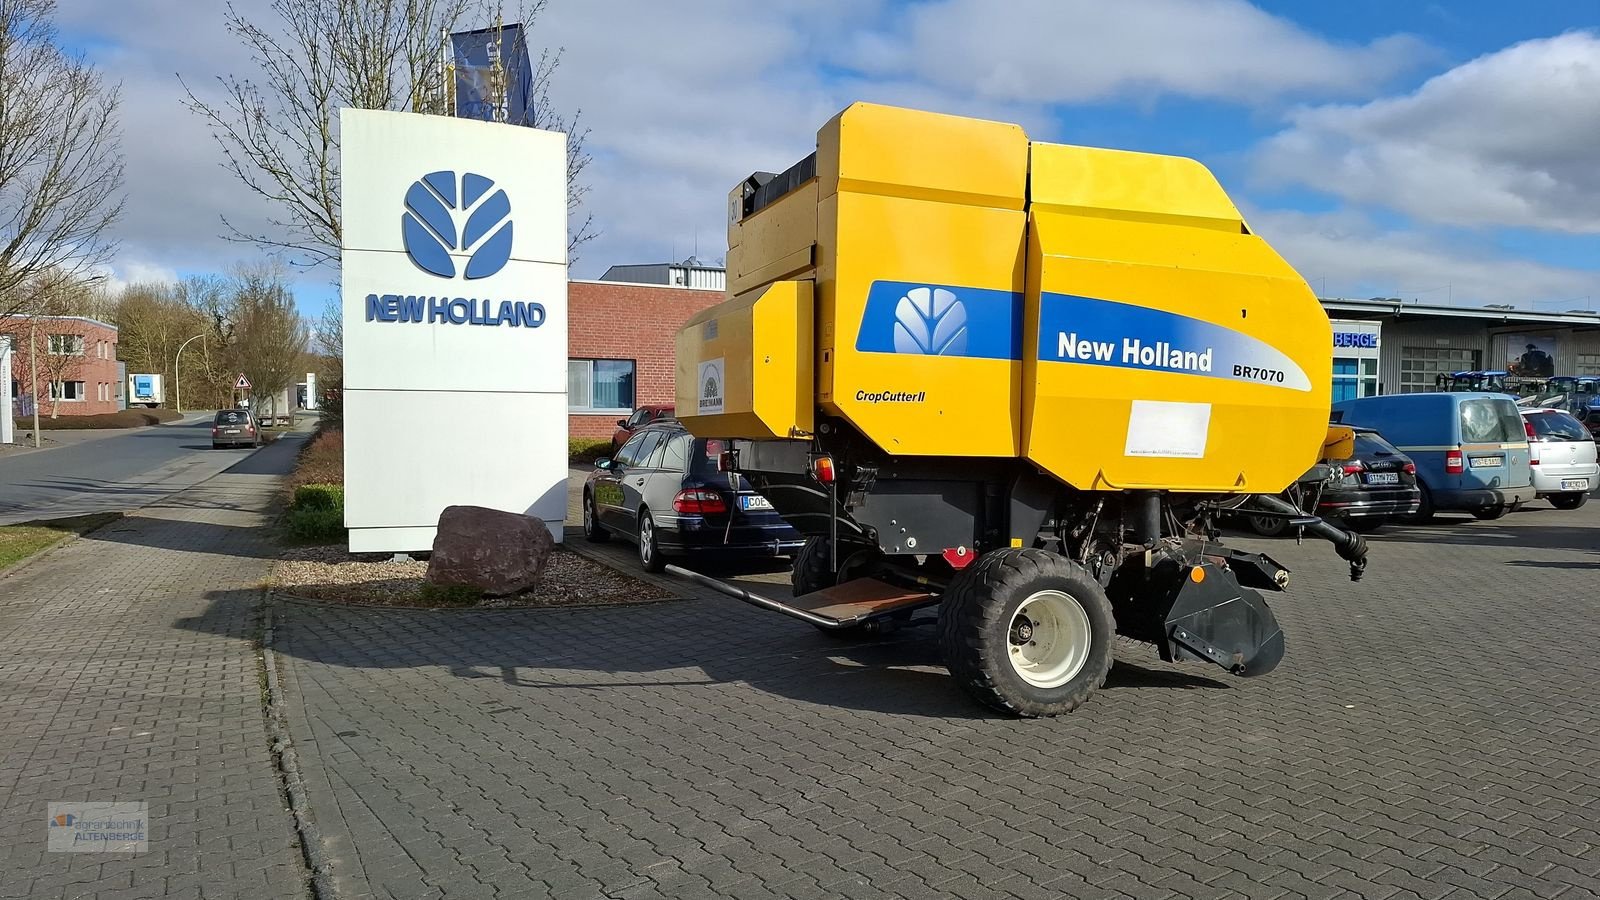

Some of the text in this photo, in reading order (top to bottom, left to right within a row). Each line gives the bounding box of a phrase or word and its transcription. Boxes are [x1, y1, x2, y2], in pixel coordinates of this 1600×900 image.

[365, 293, 546, 328] NEW HOLLAND
[1058, 331, 1213, 372] New Holland
[1233, 364, 1285, 383] BR7070
